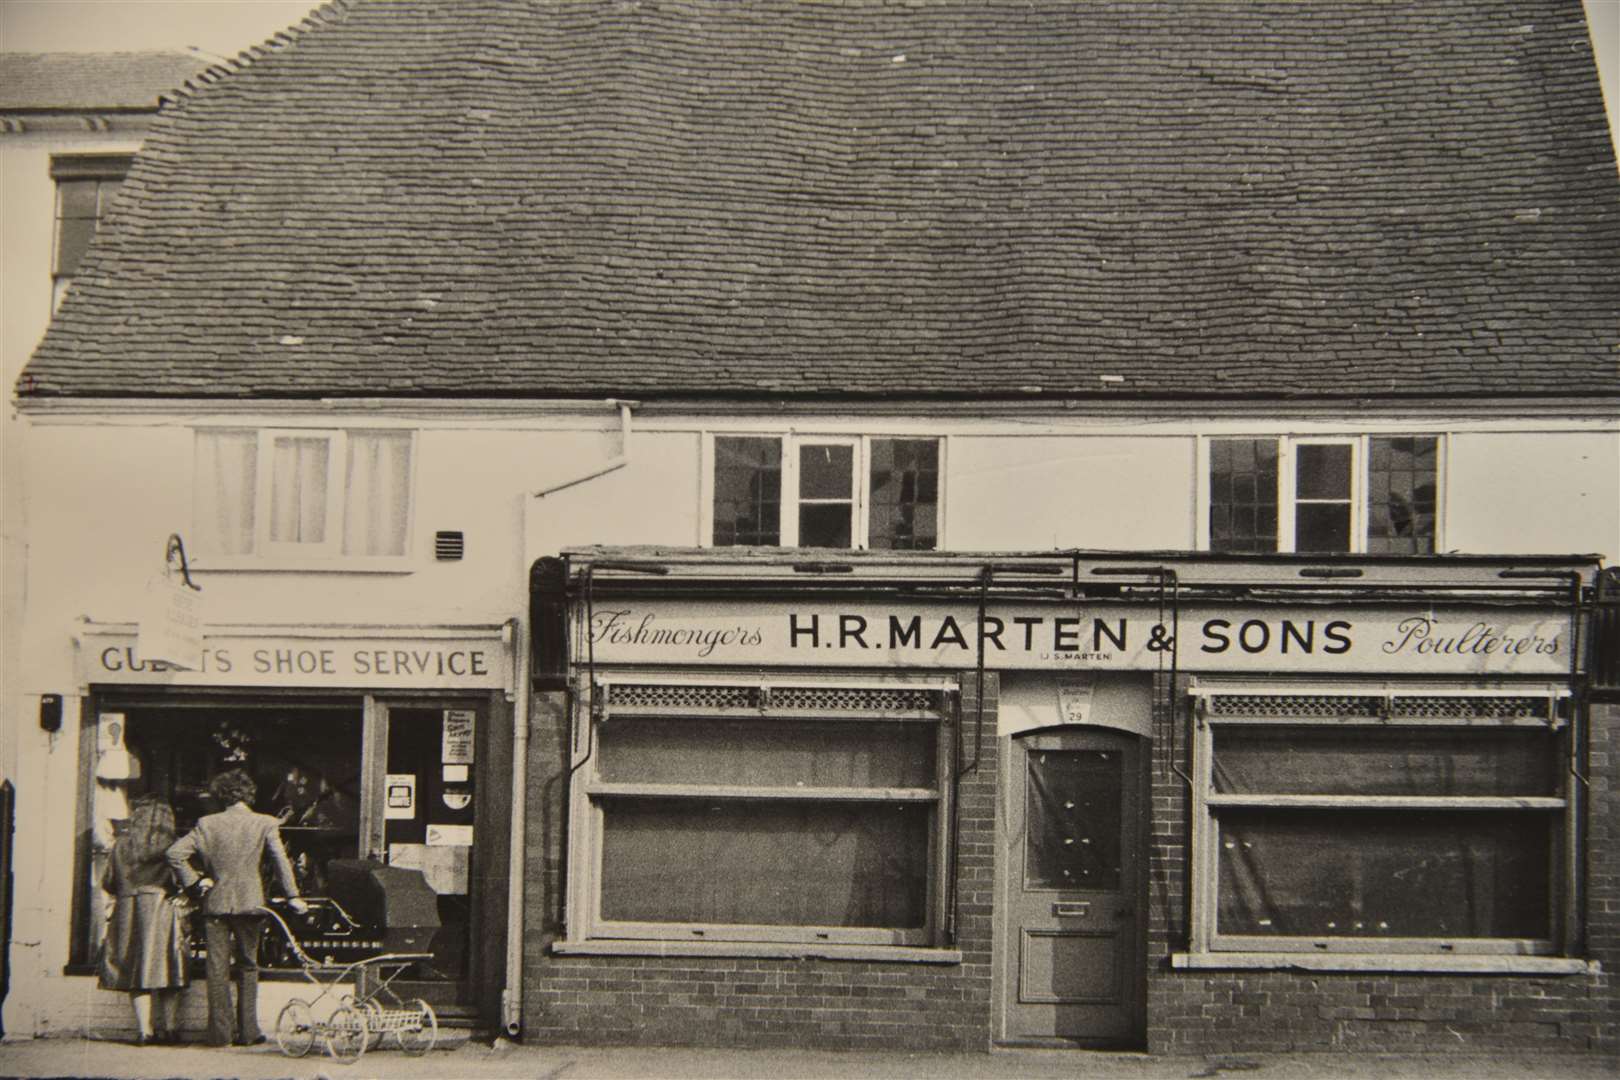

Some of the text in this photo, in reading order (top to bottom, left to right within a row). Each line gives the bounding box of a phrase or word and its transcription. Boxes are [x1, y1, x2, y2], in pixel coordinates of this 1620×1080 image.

[585, 609, 762, 657] Fishmongers
[1146, 624, 1174, 652] &
[1201, 618, 1353, 654] SONS
[1382, 617, 1559, 654] Poulterers
[101, 647, 489, 676] GUTS SHOE SERVICE
[1069, 712, 1082, 721] 29
